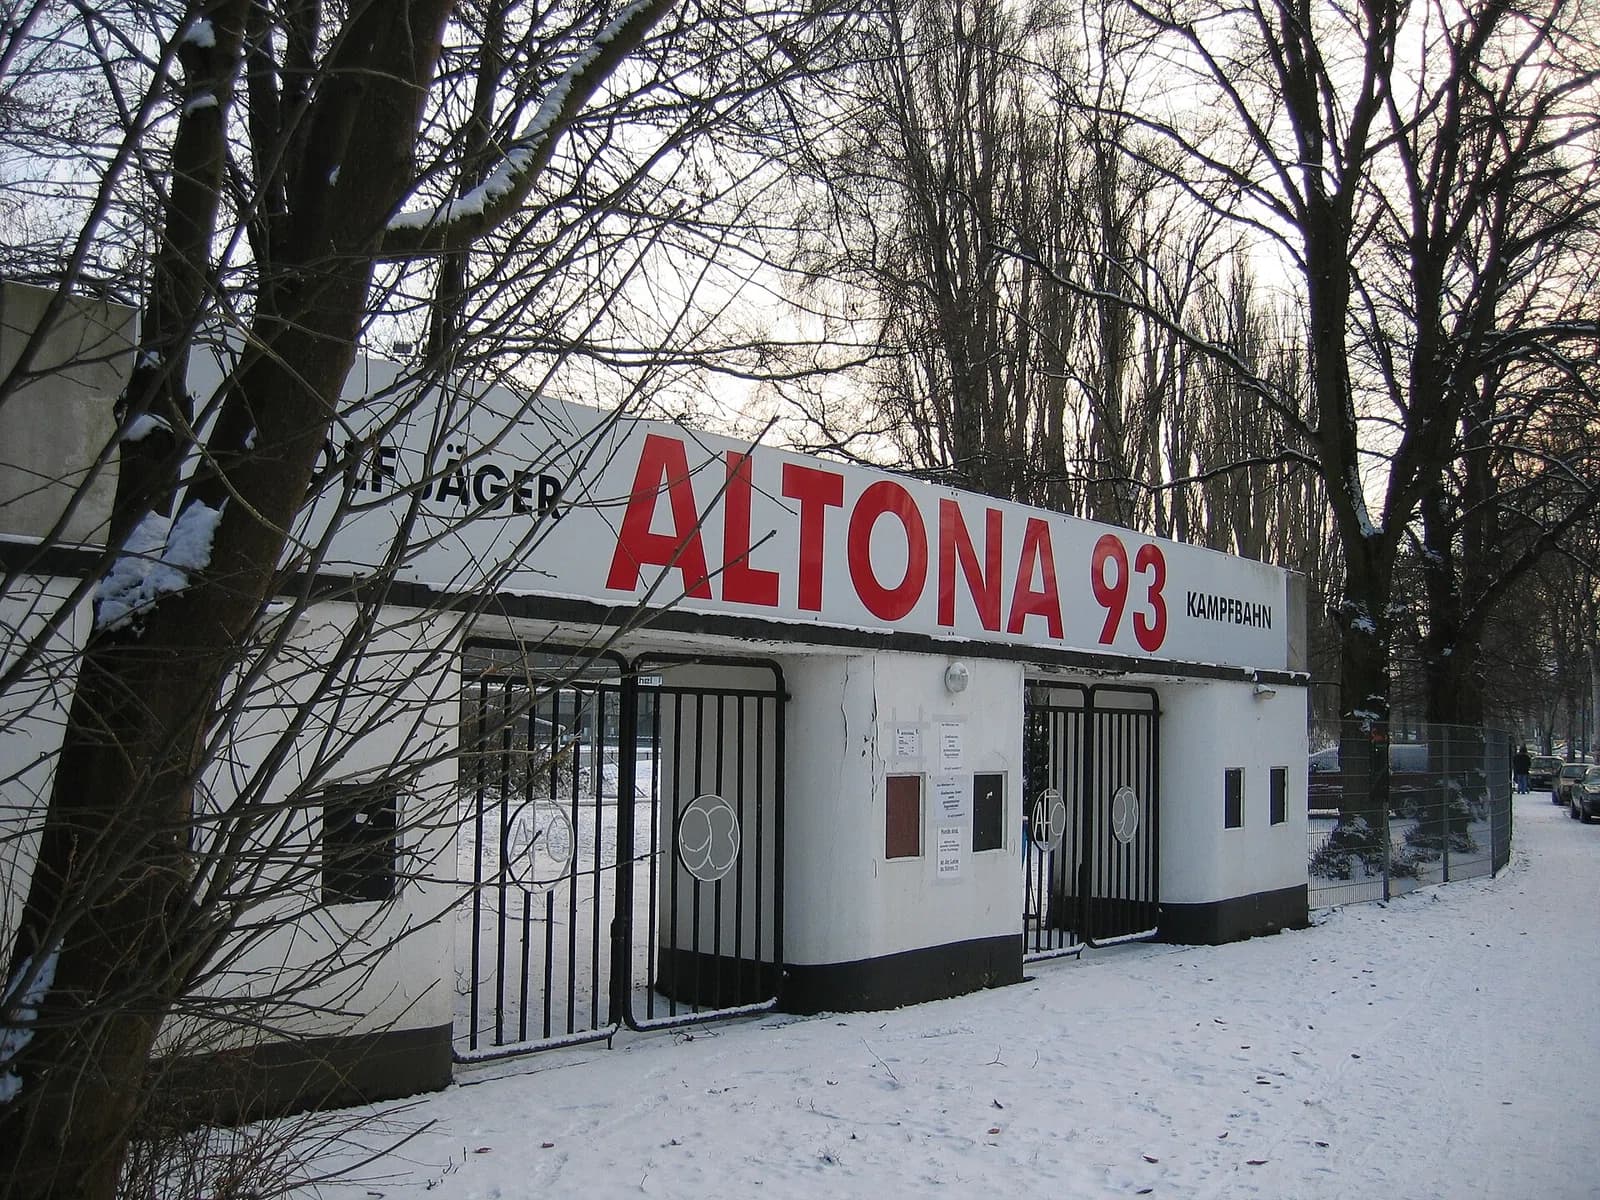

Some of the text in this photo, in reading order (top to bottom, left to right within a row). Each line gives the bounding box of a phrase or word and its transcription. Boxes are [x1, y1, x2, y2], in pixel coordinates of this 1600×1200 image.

[606, 433, 1168, 652] ALTONA 93
[1186, 591, 1272, 630] KAMPFBAHN
